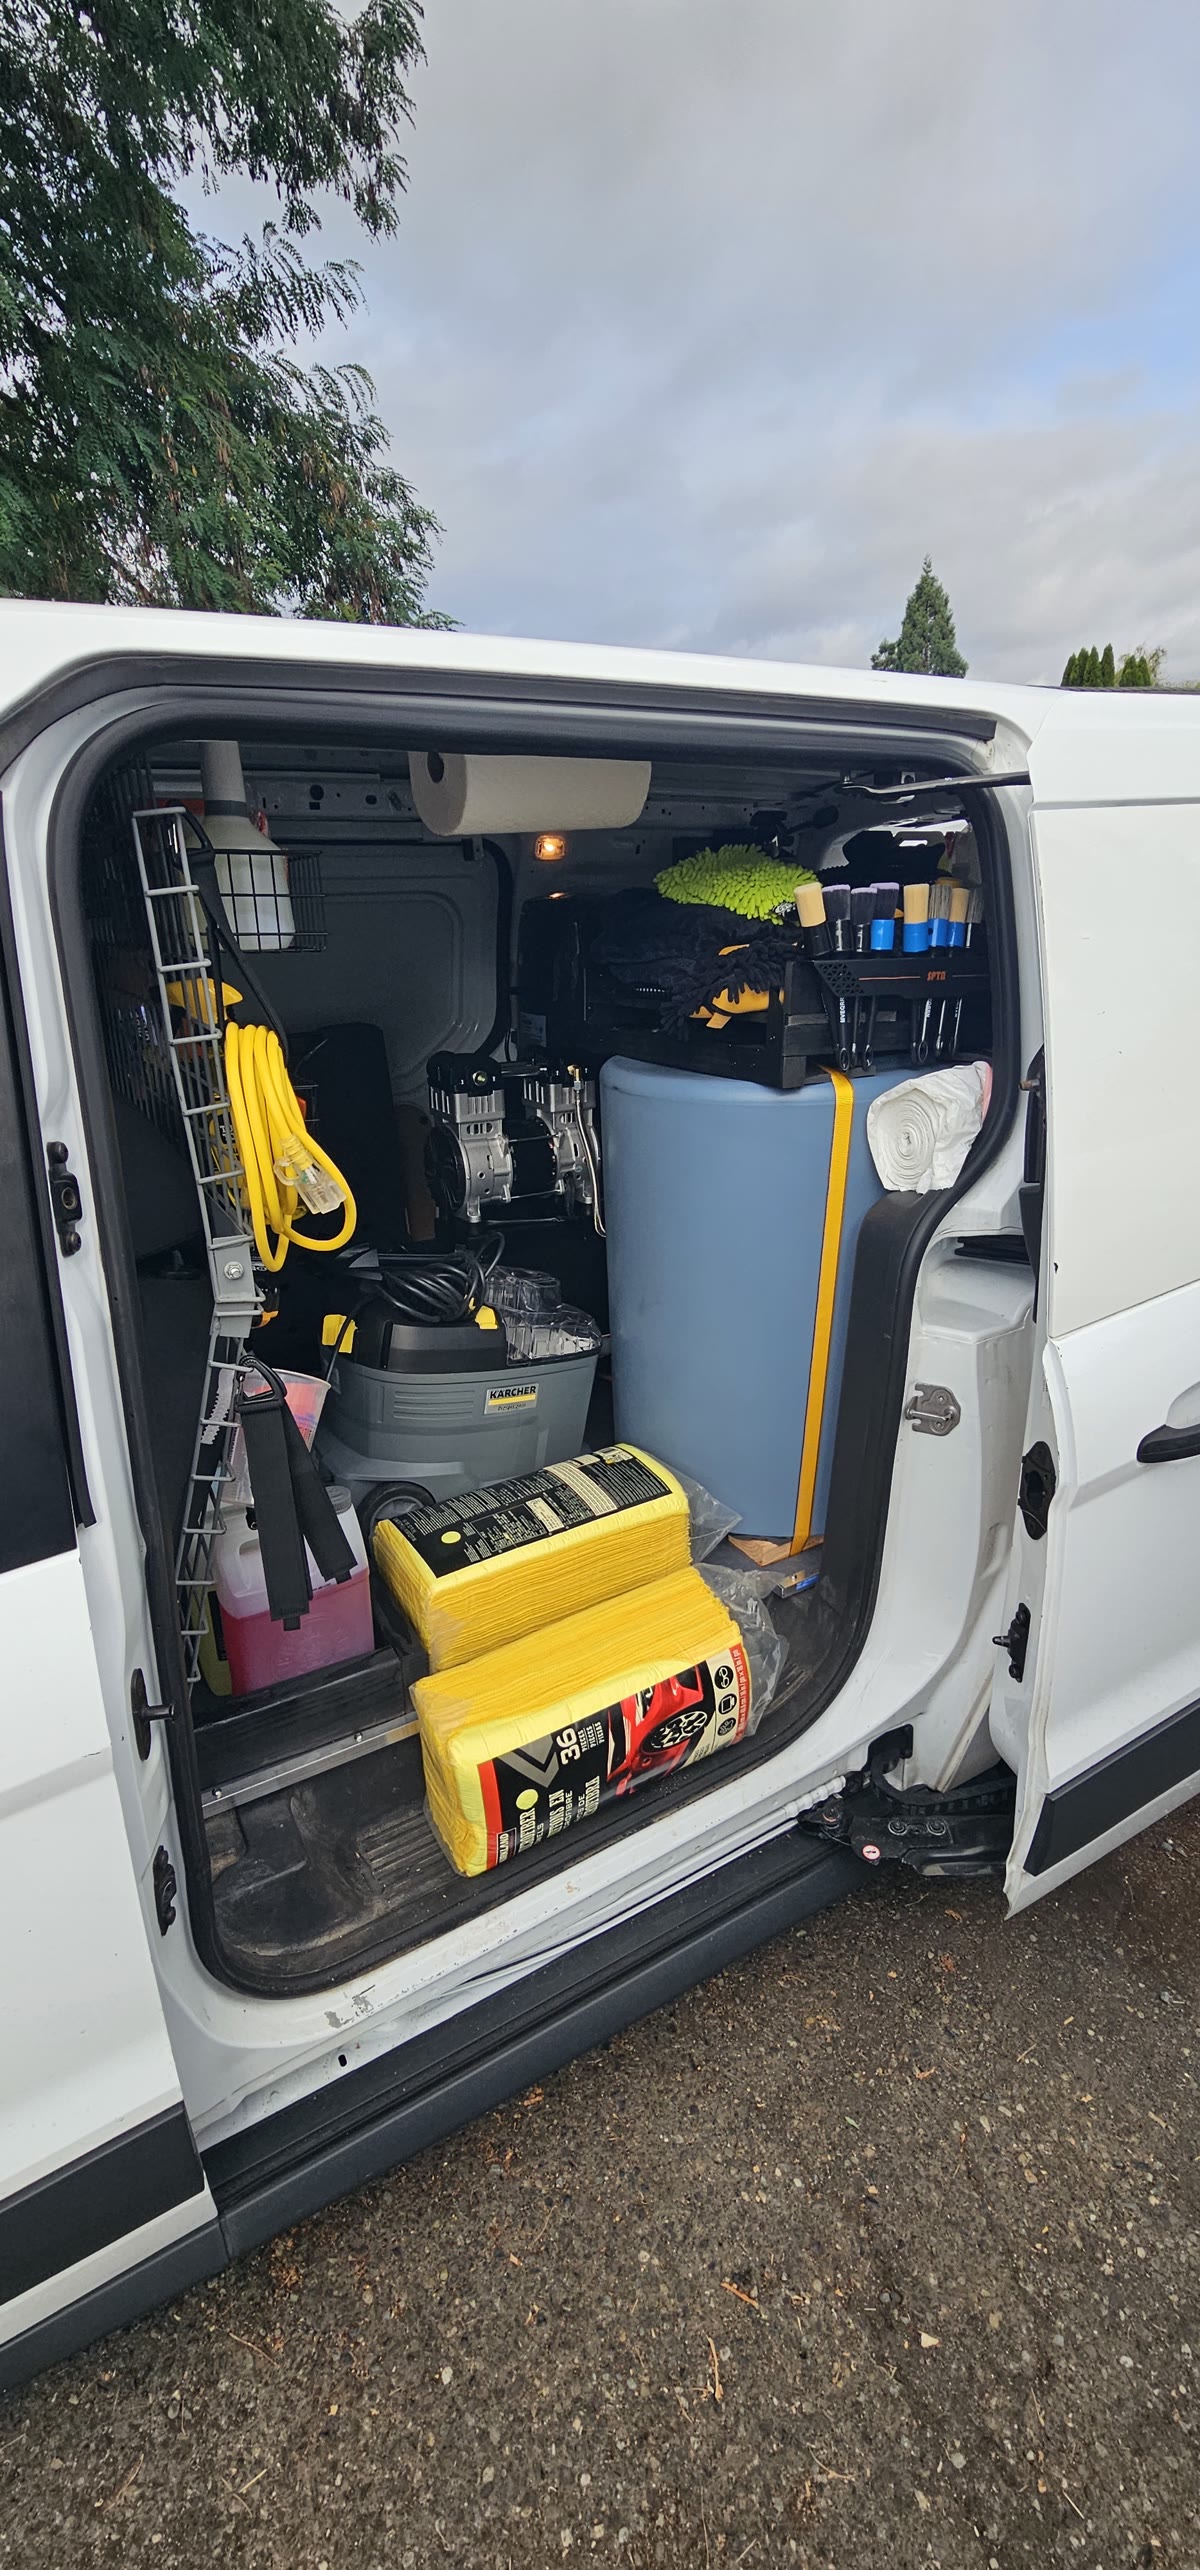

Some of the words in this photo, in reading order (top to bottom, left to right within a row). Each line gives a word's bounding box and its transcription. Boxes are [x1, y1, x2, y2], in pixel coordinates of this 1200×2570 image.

[556, 1727, 581, 1765] 36
[549, 1789, 565, 1808] EN
[578, 1794, 585, 1807] DE
[518, 1807, 536, 1853] CROFIBER
